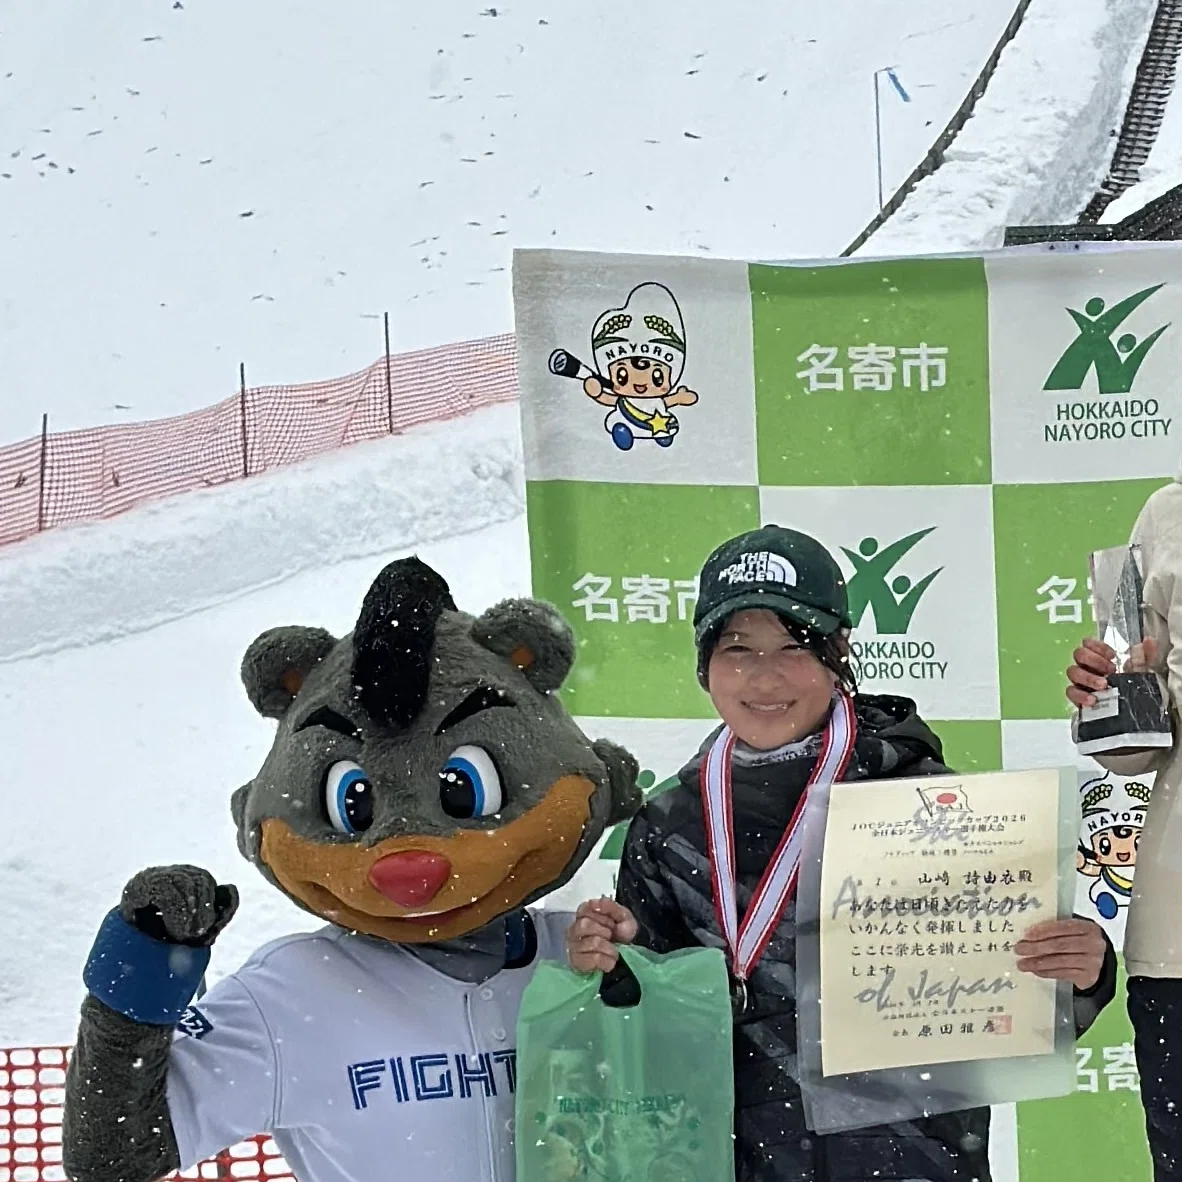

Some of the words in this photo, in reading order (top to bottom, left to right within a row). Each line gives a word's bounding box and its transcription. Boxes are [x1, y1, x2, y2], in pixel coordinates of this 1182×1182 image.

[605, 343, 674, 363] NAYORO
[796, 343, 949, 393] 名寄市
[1056, 399, 1159, 421] HOKKAIDO
[1044, 419, 1127, 443] NAYORO
[1131, 418, 1172, 438] CITY
[741, 552, 768, 564] THE
[718, 561, 767, 581] NORTH
[728, 571, 767, 585] FACE
[851, 641, 935, 659] OKKAIDO
[852, 661, 904, 679] YORO
[909, 661, 948, 679] CITY
[1088, 812, 1143, 832] NAYOR
[849, 919, 1014, 935] いかんなく発揮しました
[851, 941, 1014, 957] ここに栄光を讃えこれを
[852, 965, 893, 978] します
[907, 968, 1018, 1006] Japan
[1075, 1043, 1140, 1093] 名寄
[347, 1049, 517, 1110] FIGHT
